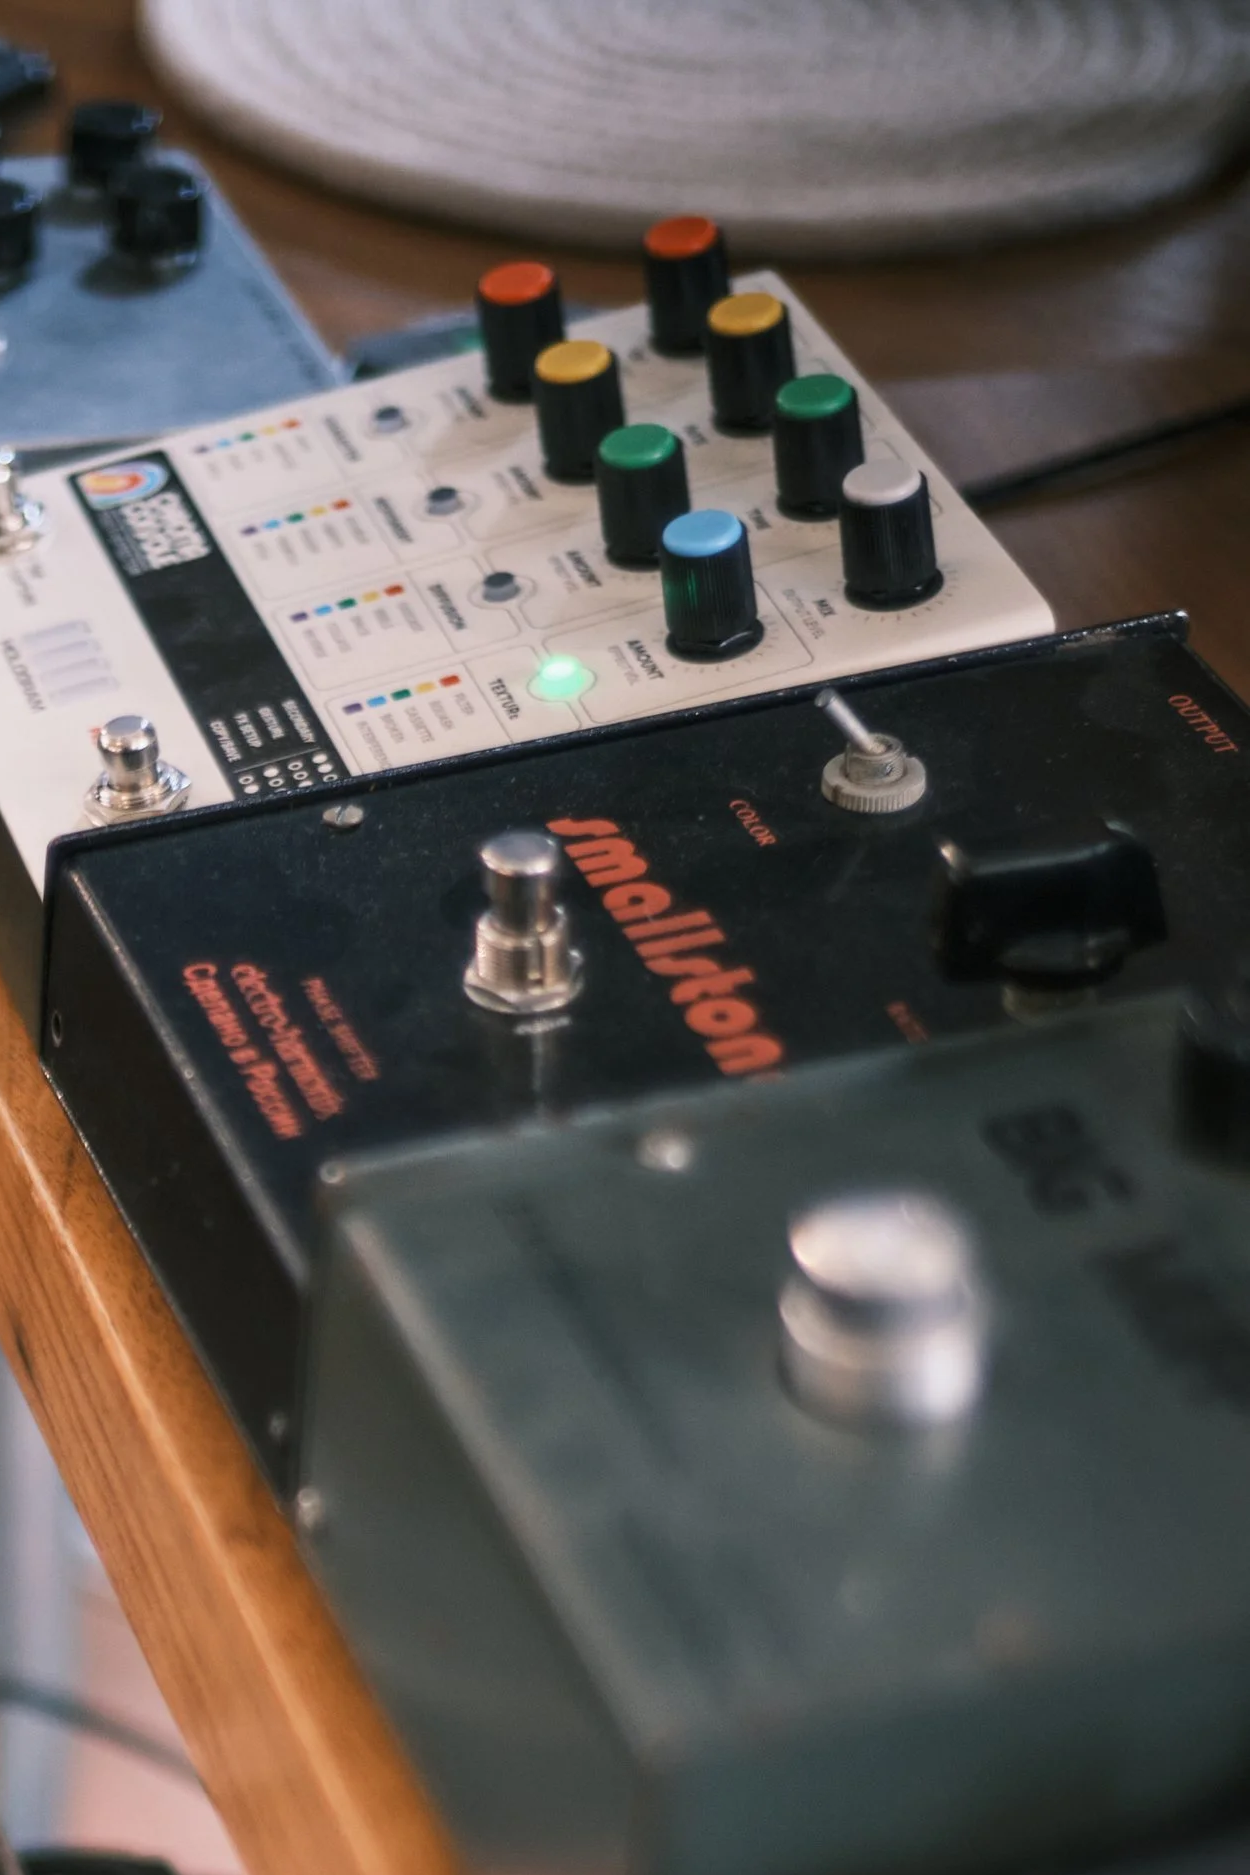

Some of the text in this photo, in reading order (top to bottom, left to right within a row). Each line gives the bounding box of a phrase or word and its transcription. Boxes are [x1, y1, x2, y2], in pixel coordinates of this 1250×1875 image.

[813, 599, 837, 617] MIX
[1, 638, 46, 713] HOLOGRAM
[625, 639, 665, 681] AMOUNT
[258, 706, 285, 739] GESTURE
[282, 699, 316, 743] SECONDARY
[404, 705, 436, 744] CASSETTE
[455, 692, 475, 717] FILTER
[1168, 694, 1239, 752] OUTPUT
[210, 719, 242, 763] COPY/SAVE
[239, 722, 263, 748] SETUP
[729, 800, 777, 847] COLOR
[546, 818, 783, 1077] smallston
[301, 976, 380, 1080] PHASE SHIFTER
[183, 962, 249, 1048] Сделано
[238, 1061, 304, 1141] России
